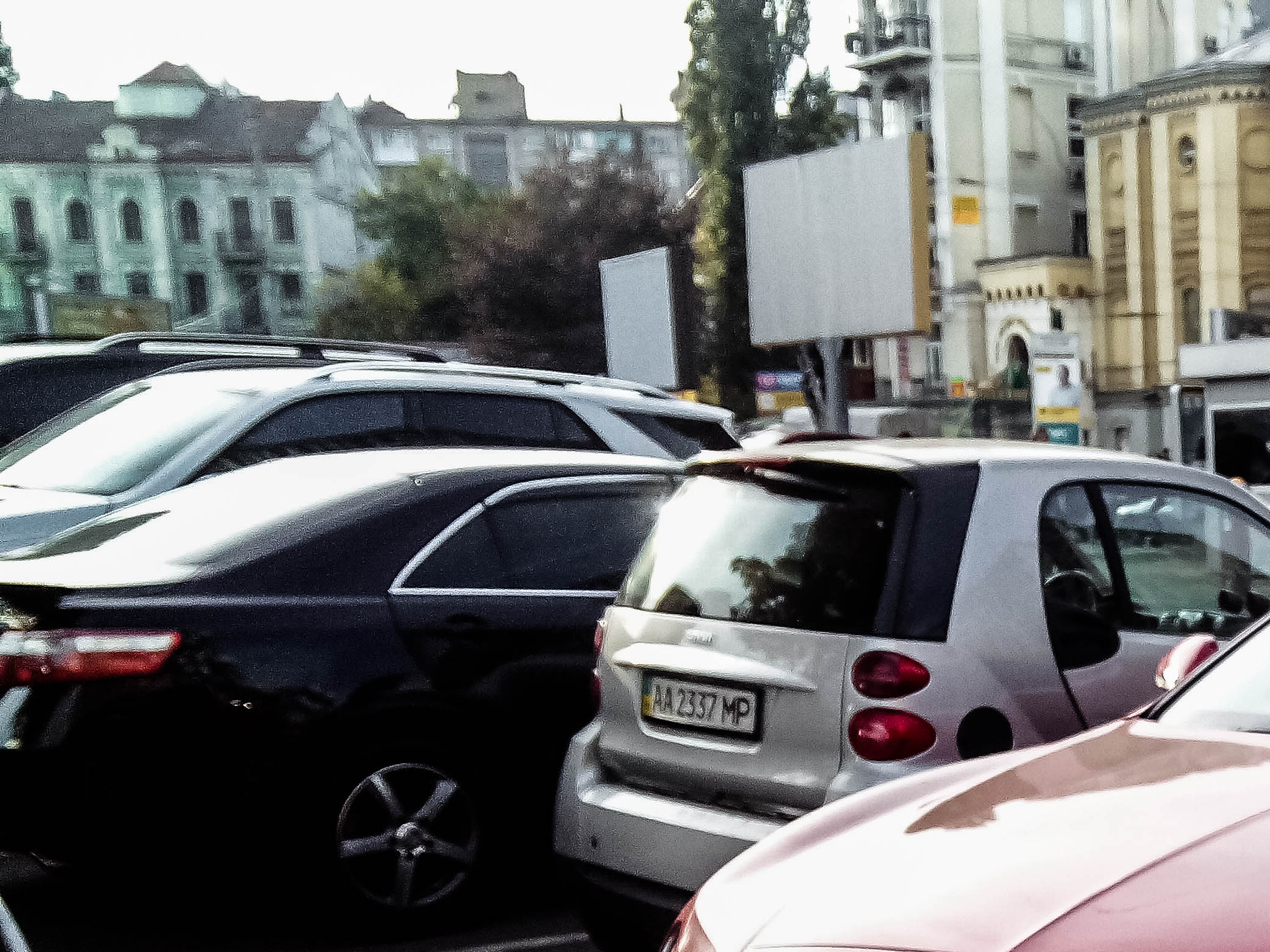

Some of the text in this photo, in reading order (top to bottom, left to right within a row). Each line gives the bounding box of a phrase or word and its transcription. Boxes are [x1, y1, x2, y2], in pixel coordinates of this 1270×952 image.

[653, 685, 750, 726] AA 2337 MP
